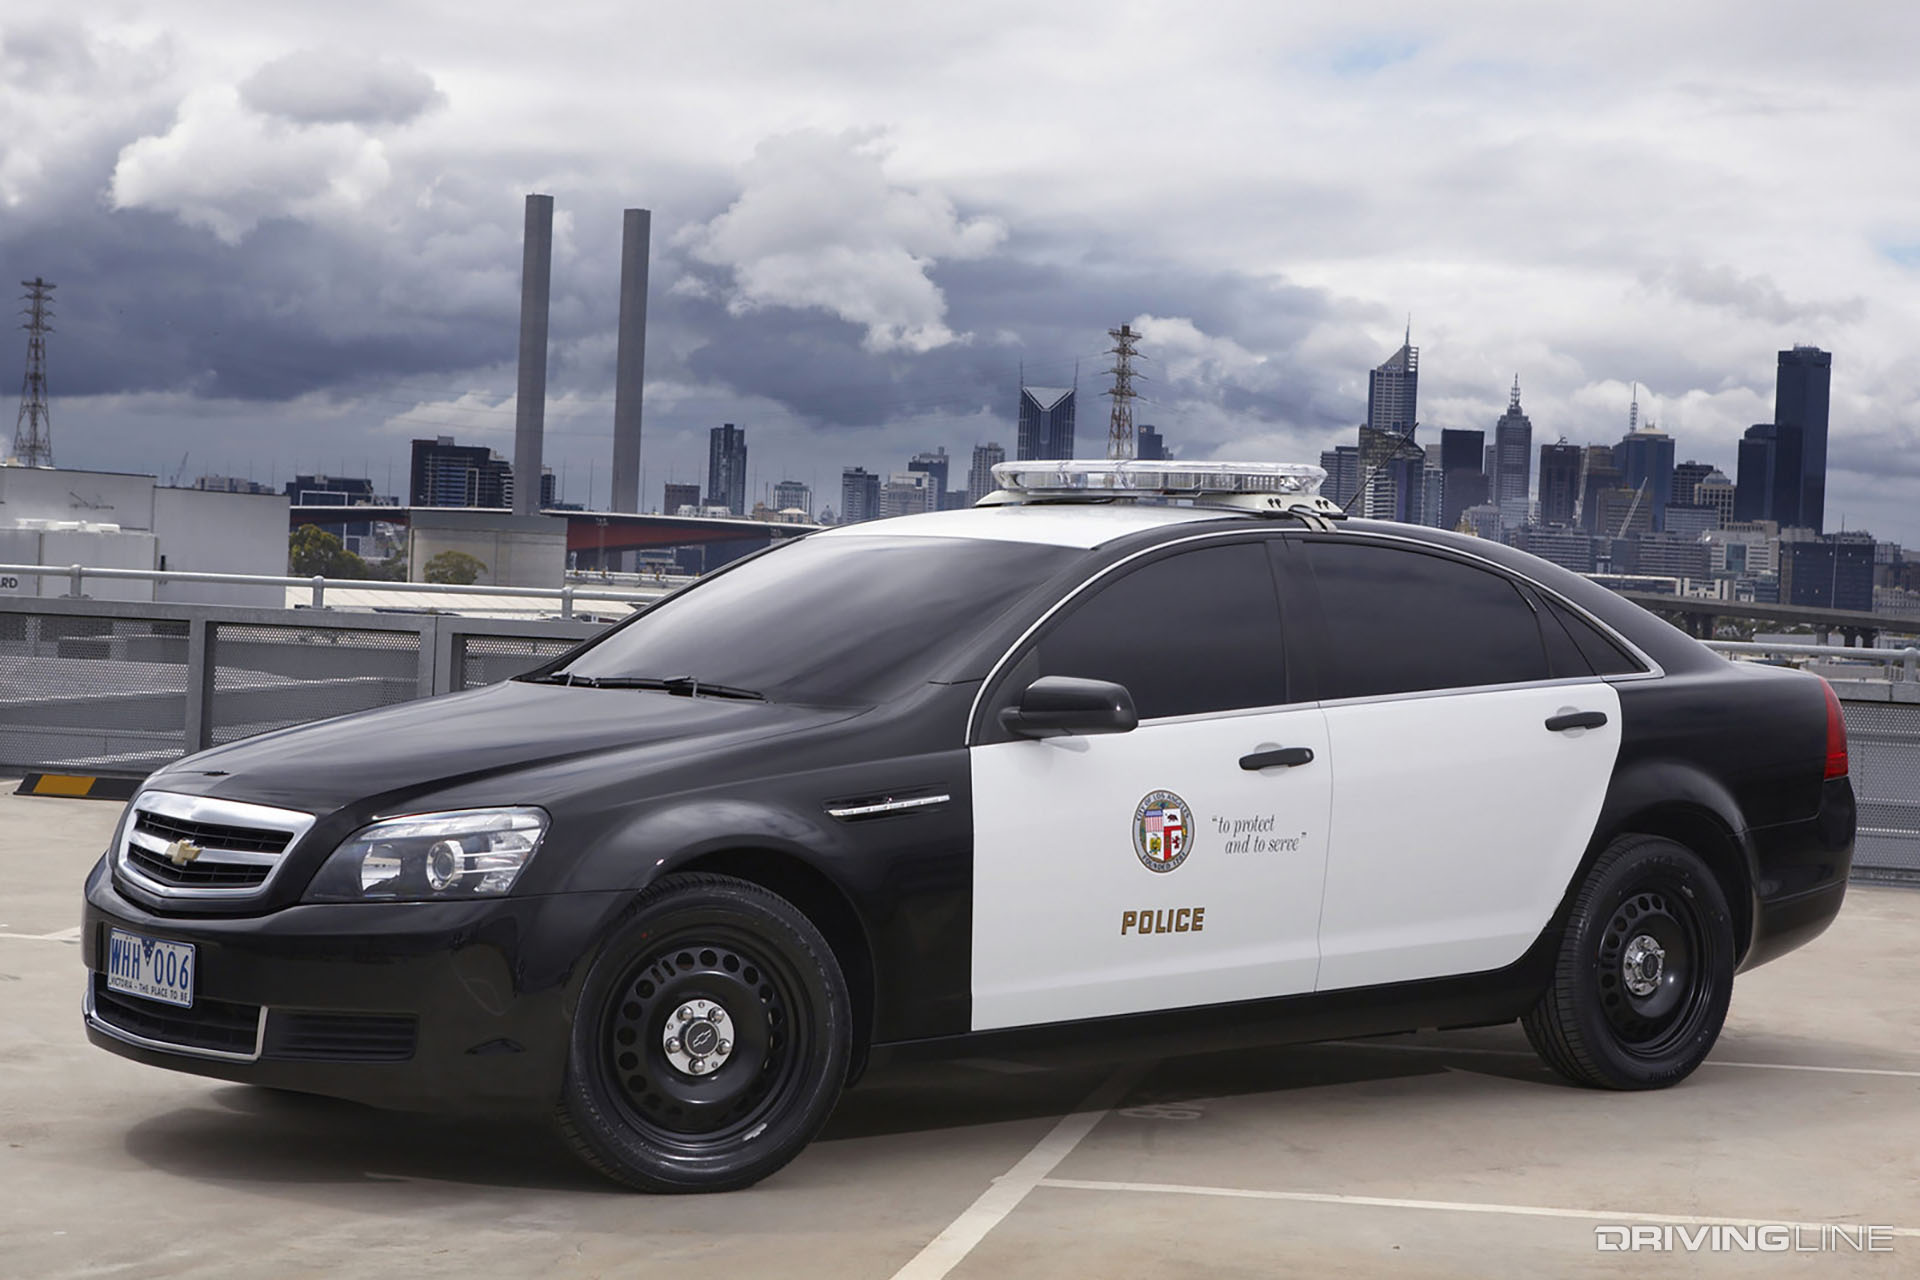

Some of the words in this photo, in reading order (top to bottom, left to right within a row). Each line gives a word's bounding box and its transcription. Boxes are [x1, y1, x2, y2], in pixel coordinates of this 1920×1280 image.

[0, 577, 18, 588] RD
[1233, 814, 1275, 837] protect
[1225, 834, 1250, 854] and
[1254, 836, 1265, 853] to
[1121, 907, 1205, 935] POLICE
[111, 938, 141, 980] WHH
[154, 948, 189, 990] 006
[151, 985, 168, 998] PLACE
